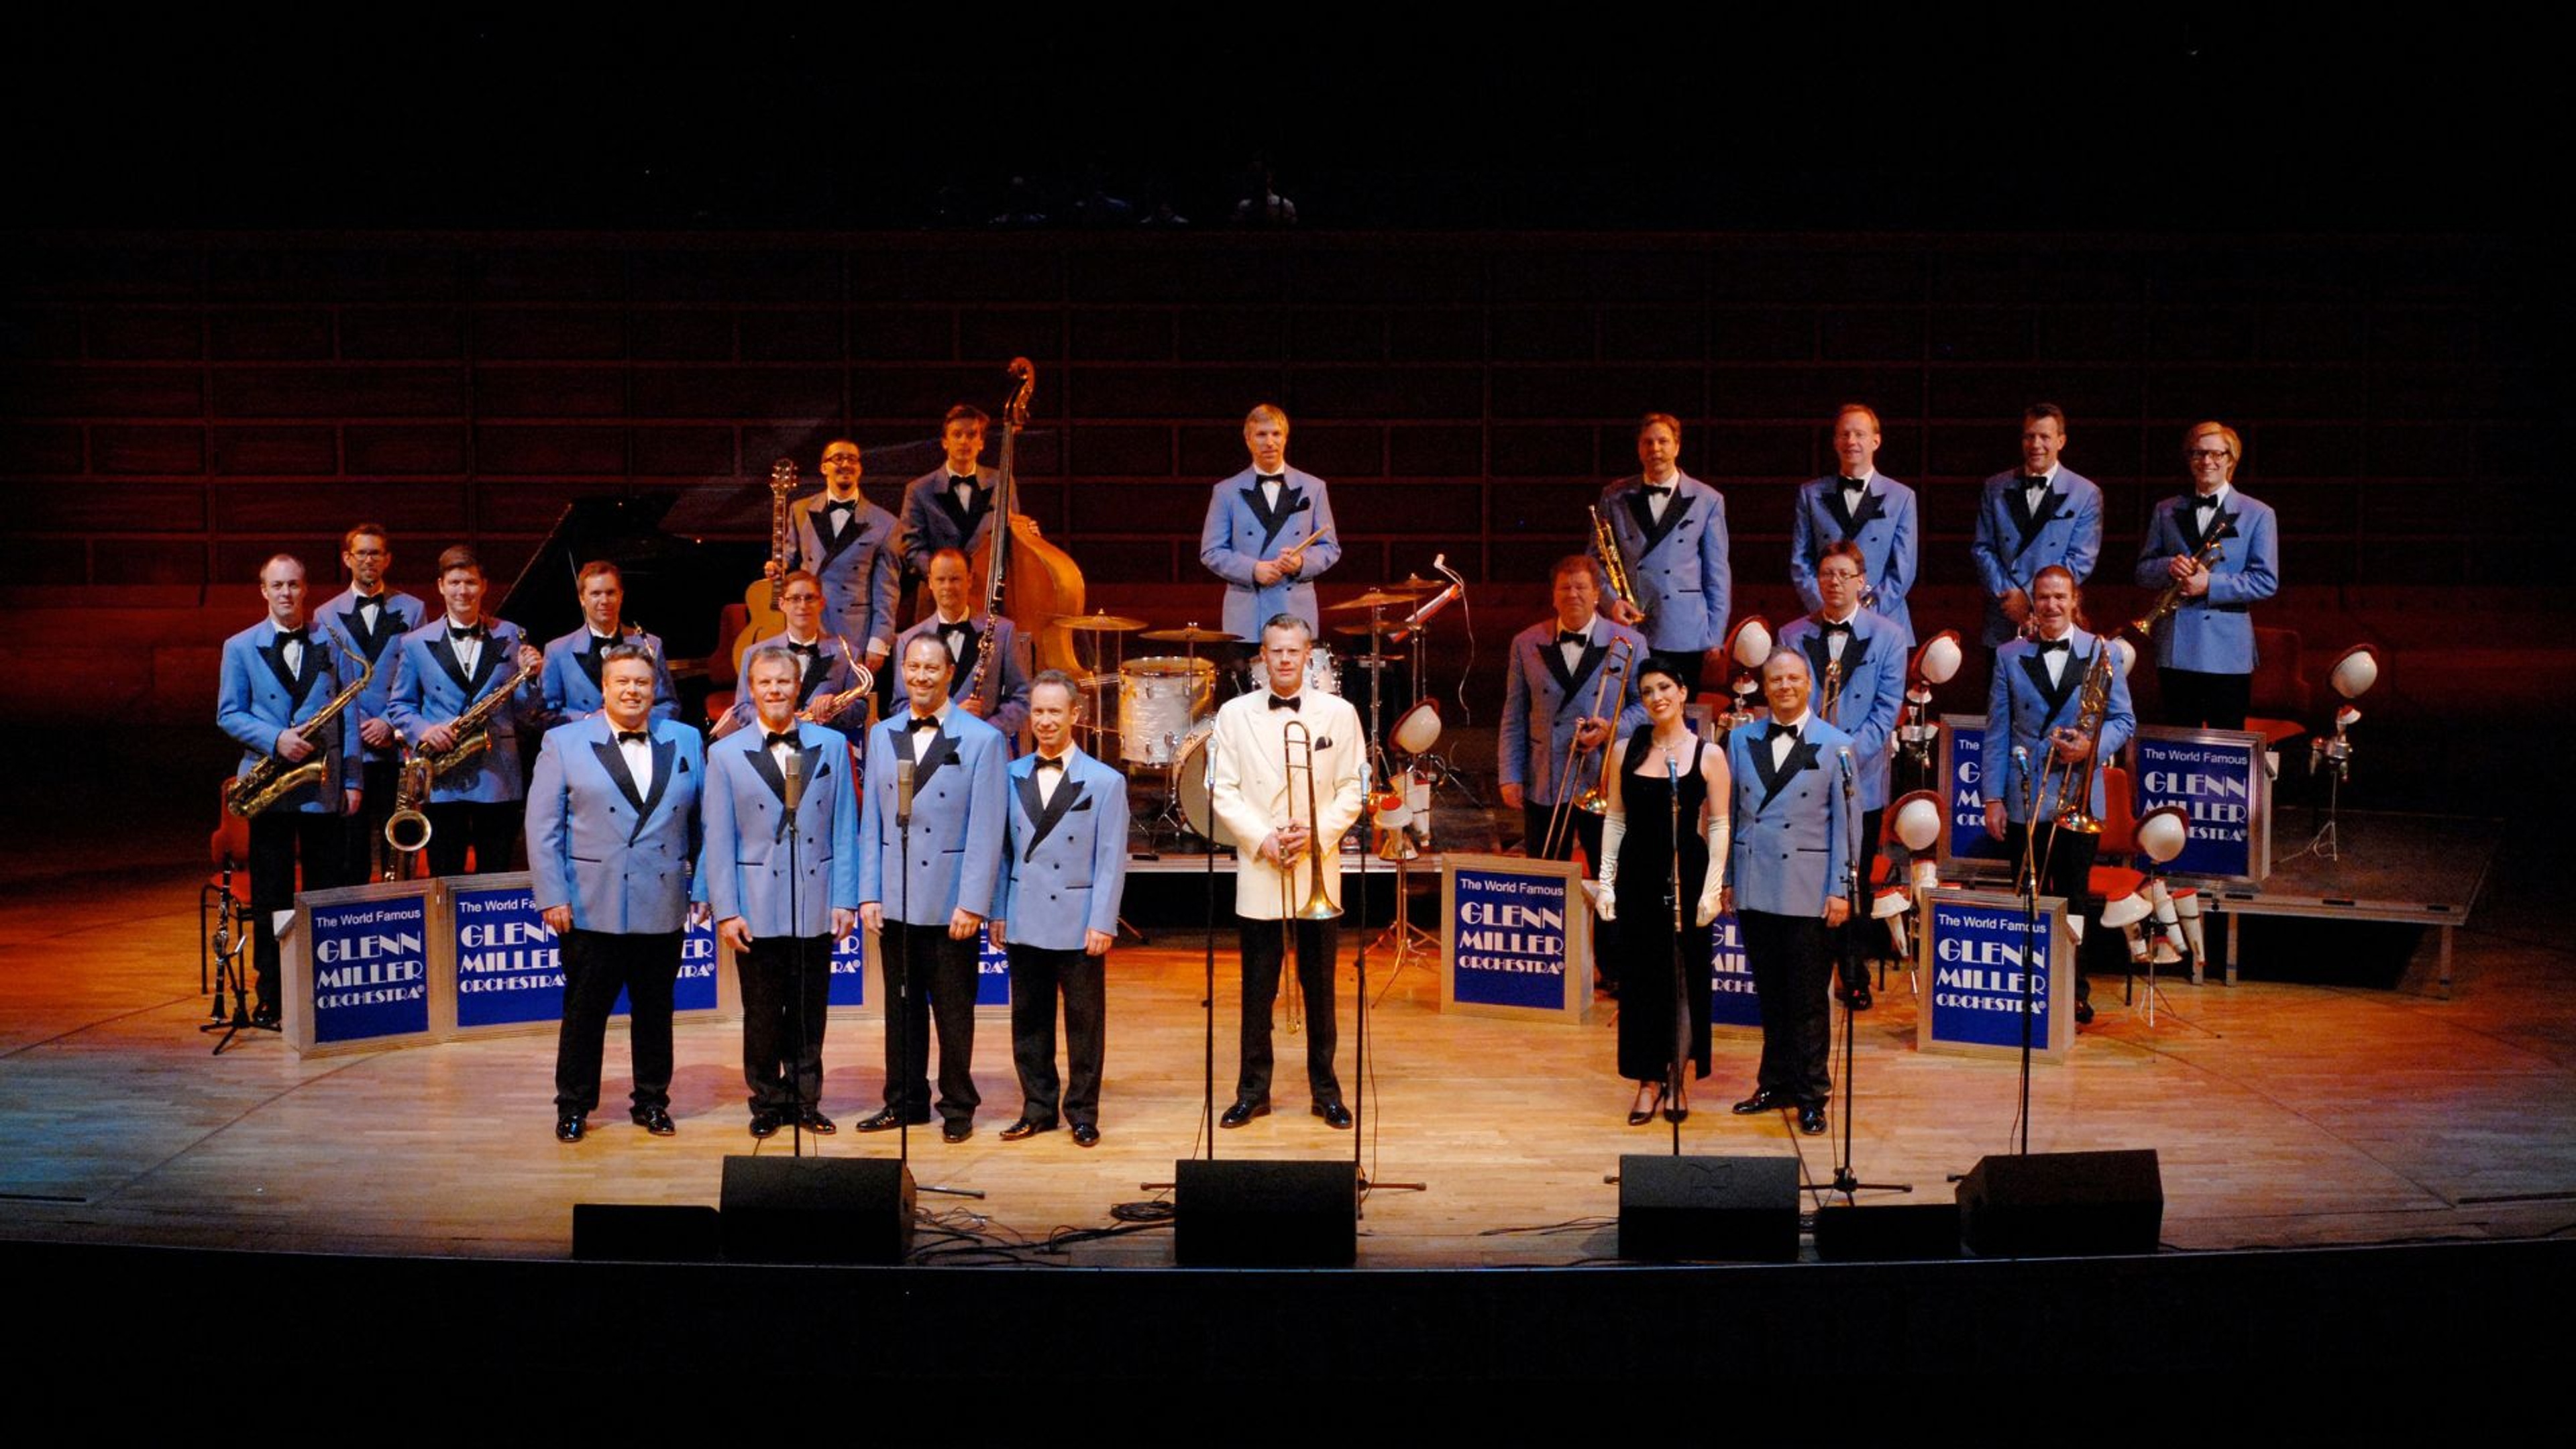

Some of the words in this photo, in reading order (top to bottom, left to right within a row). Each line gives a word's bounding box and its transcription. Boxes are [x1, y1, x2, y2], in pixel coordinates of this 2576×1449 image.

[1958, 739, 1980, 751] The
[2144, 748, 2165, 760] The
[2168, 750, 2200, 762] World
[2203, 752, 2248, 765] Famous
[2144, 771, 2247, 799] GLENN
[1460, 878, 1482, 891] The
[1484, 879, 1516, 894] World
[1519, 882, 1564, 896] Famous
[315, 916, 337, 928] The
[339, 912, 373, 926] World
[376, 909, 421, 922] Famous
[459, 901, 482, 913] The
[484, 898, 518, 912] World
[1460, 901, 1563, 931] GLENN
[1938, 913, 1961, 927] The
[1963, 916, 1997, 930] World
[317, 930, 421, 963] GLENN
[1459, 930, 1564, 957] MILLER
[1938, 937, 2045, 969] GLENN
[317, 960, 423, 990] MILLER
[1936, 967, 2046, 995] MILLER
